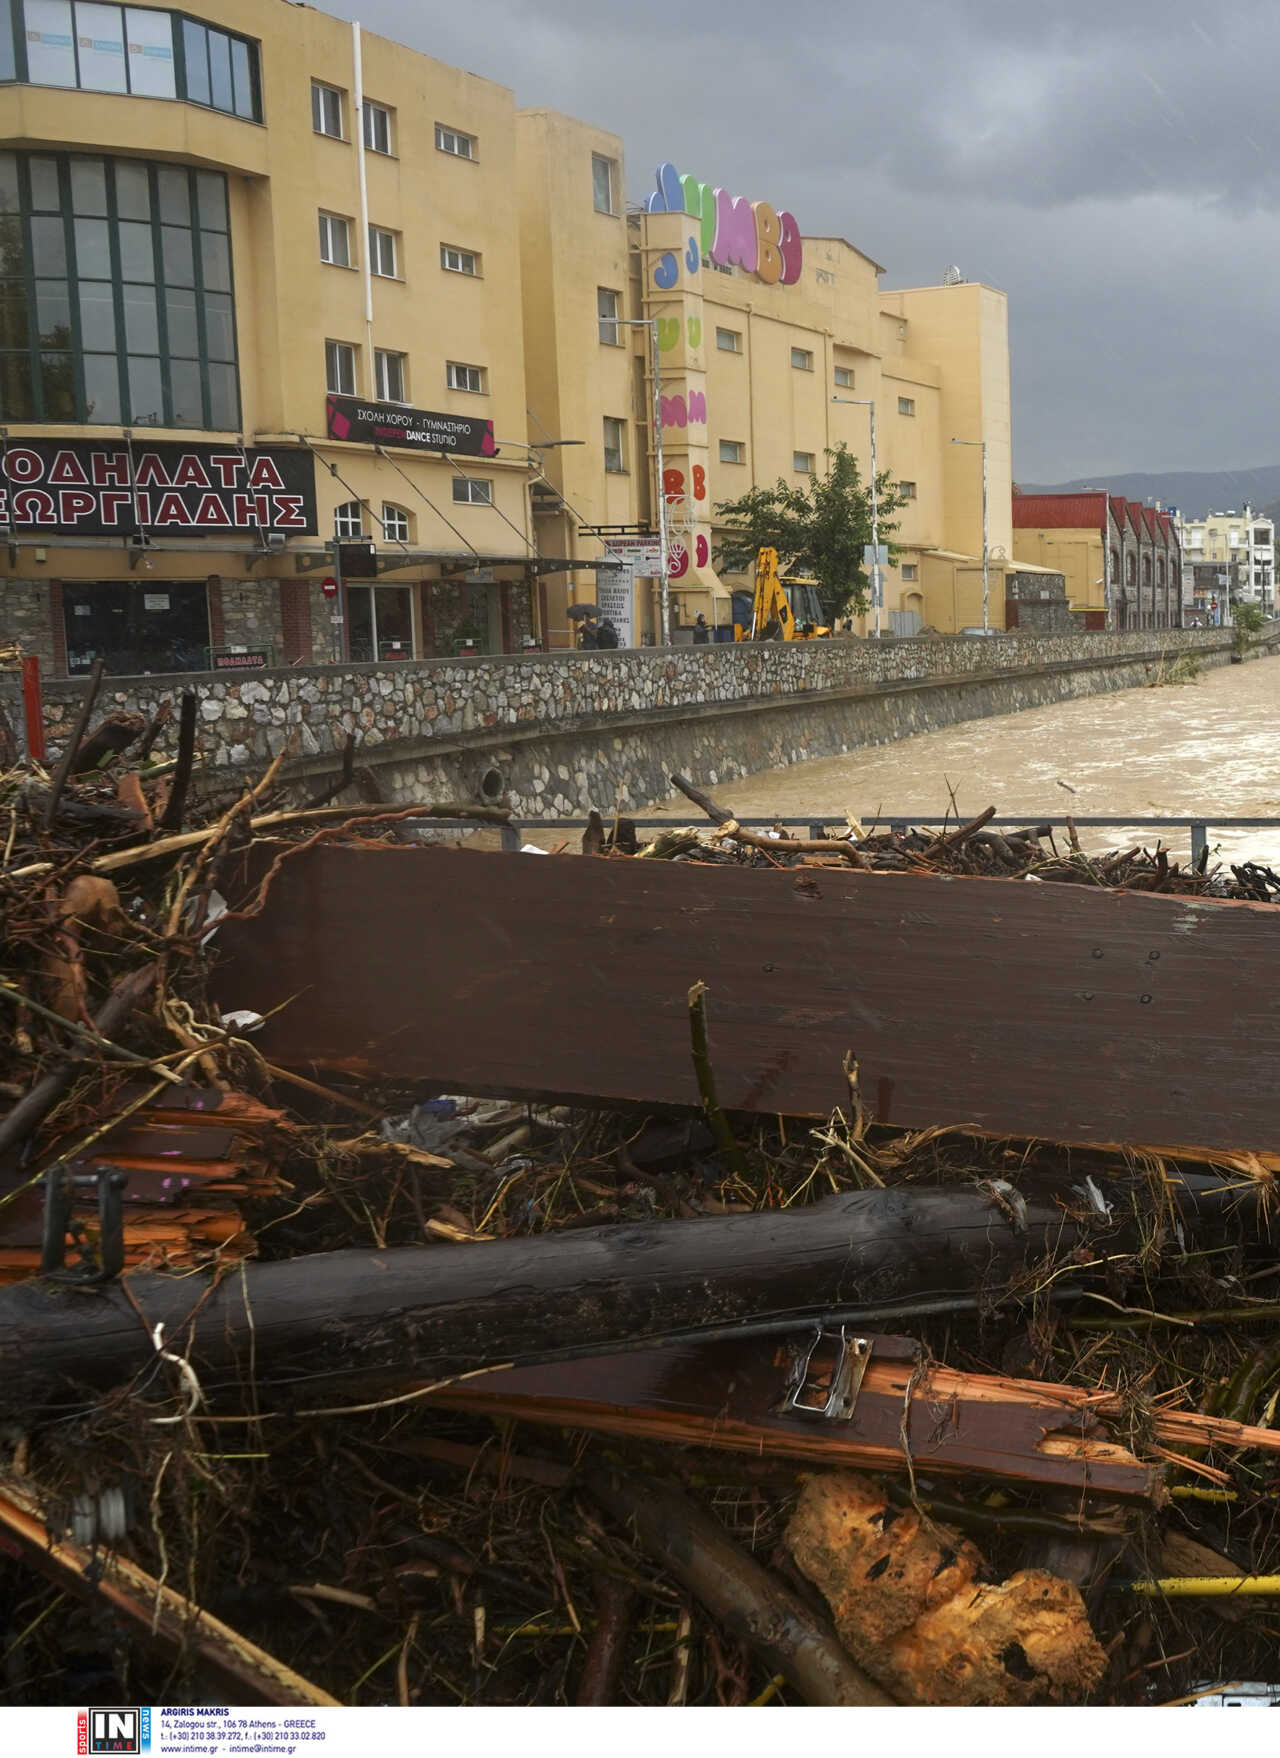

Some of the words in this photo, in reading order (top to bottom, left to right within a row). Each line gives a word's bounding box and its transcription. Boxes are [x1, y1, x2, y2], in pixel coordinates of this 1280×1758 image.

[357, 408, 385, 423] ΣΧΟΛΗ
[386, 413, 413, 427] ΧΟΡΟΥ
[423, 418, 471, 435] ΓΥΜΝΑΣΤΗΡΙΟ
[431, 434, 457, 447] STUDIO
